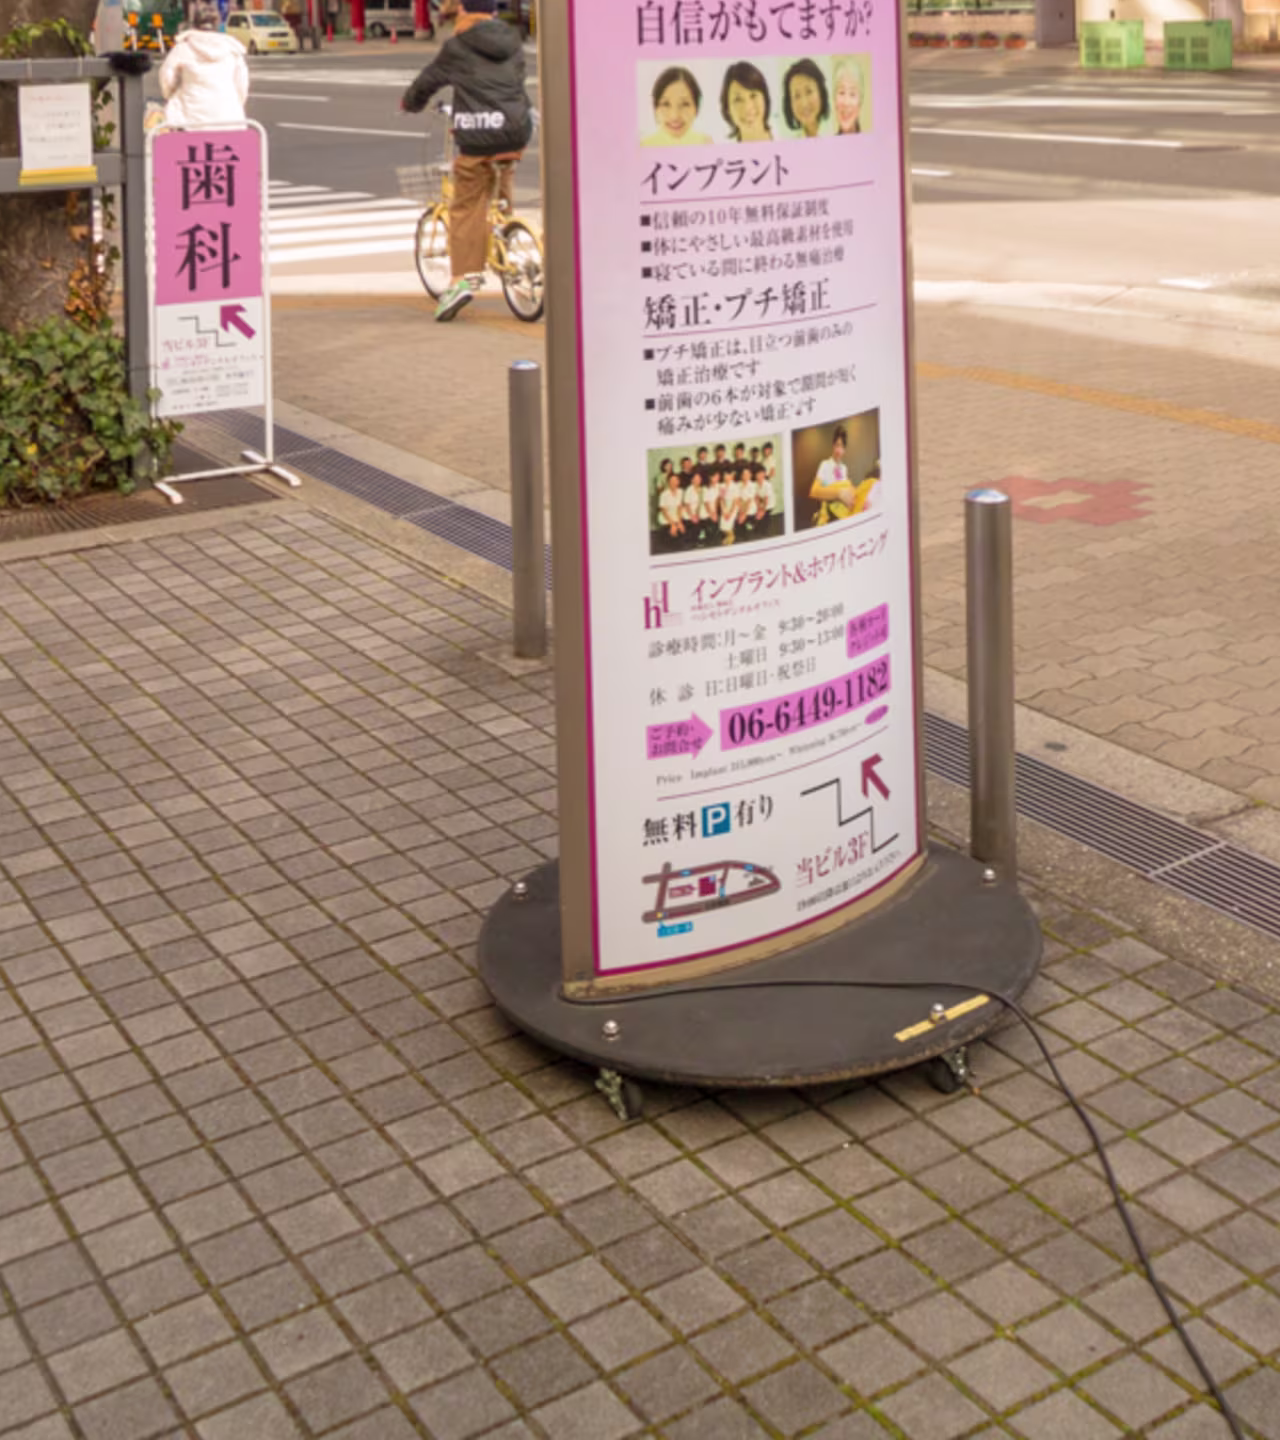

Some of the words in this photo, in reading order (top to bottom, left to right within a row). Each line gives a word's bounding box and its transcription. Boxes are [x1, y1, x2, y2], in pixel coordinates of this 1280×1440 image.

[640, 155, 790, 196] インプラント
[175, 142, 241, 292] 歯科
[644, 277, 832, 331] 矯正・プチ矯正
[656, 359, 761, 387] 矯正治療です
[728, 660, 888, 746] 06-6449-1182
[795, 830, 870, 888] 当ビル3F
